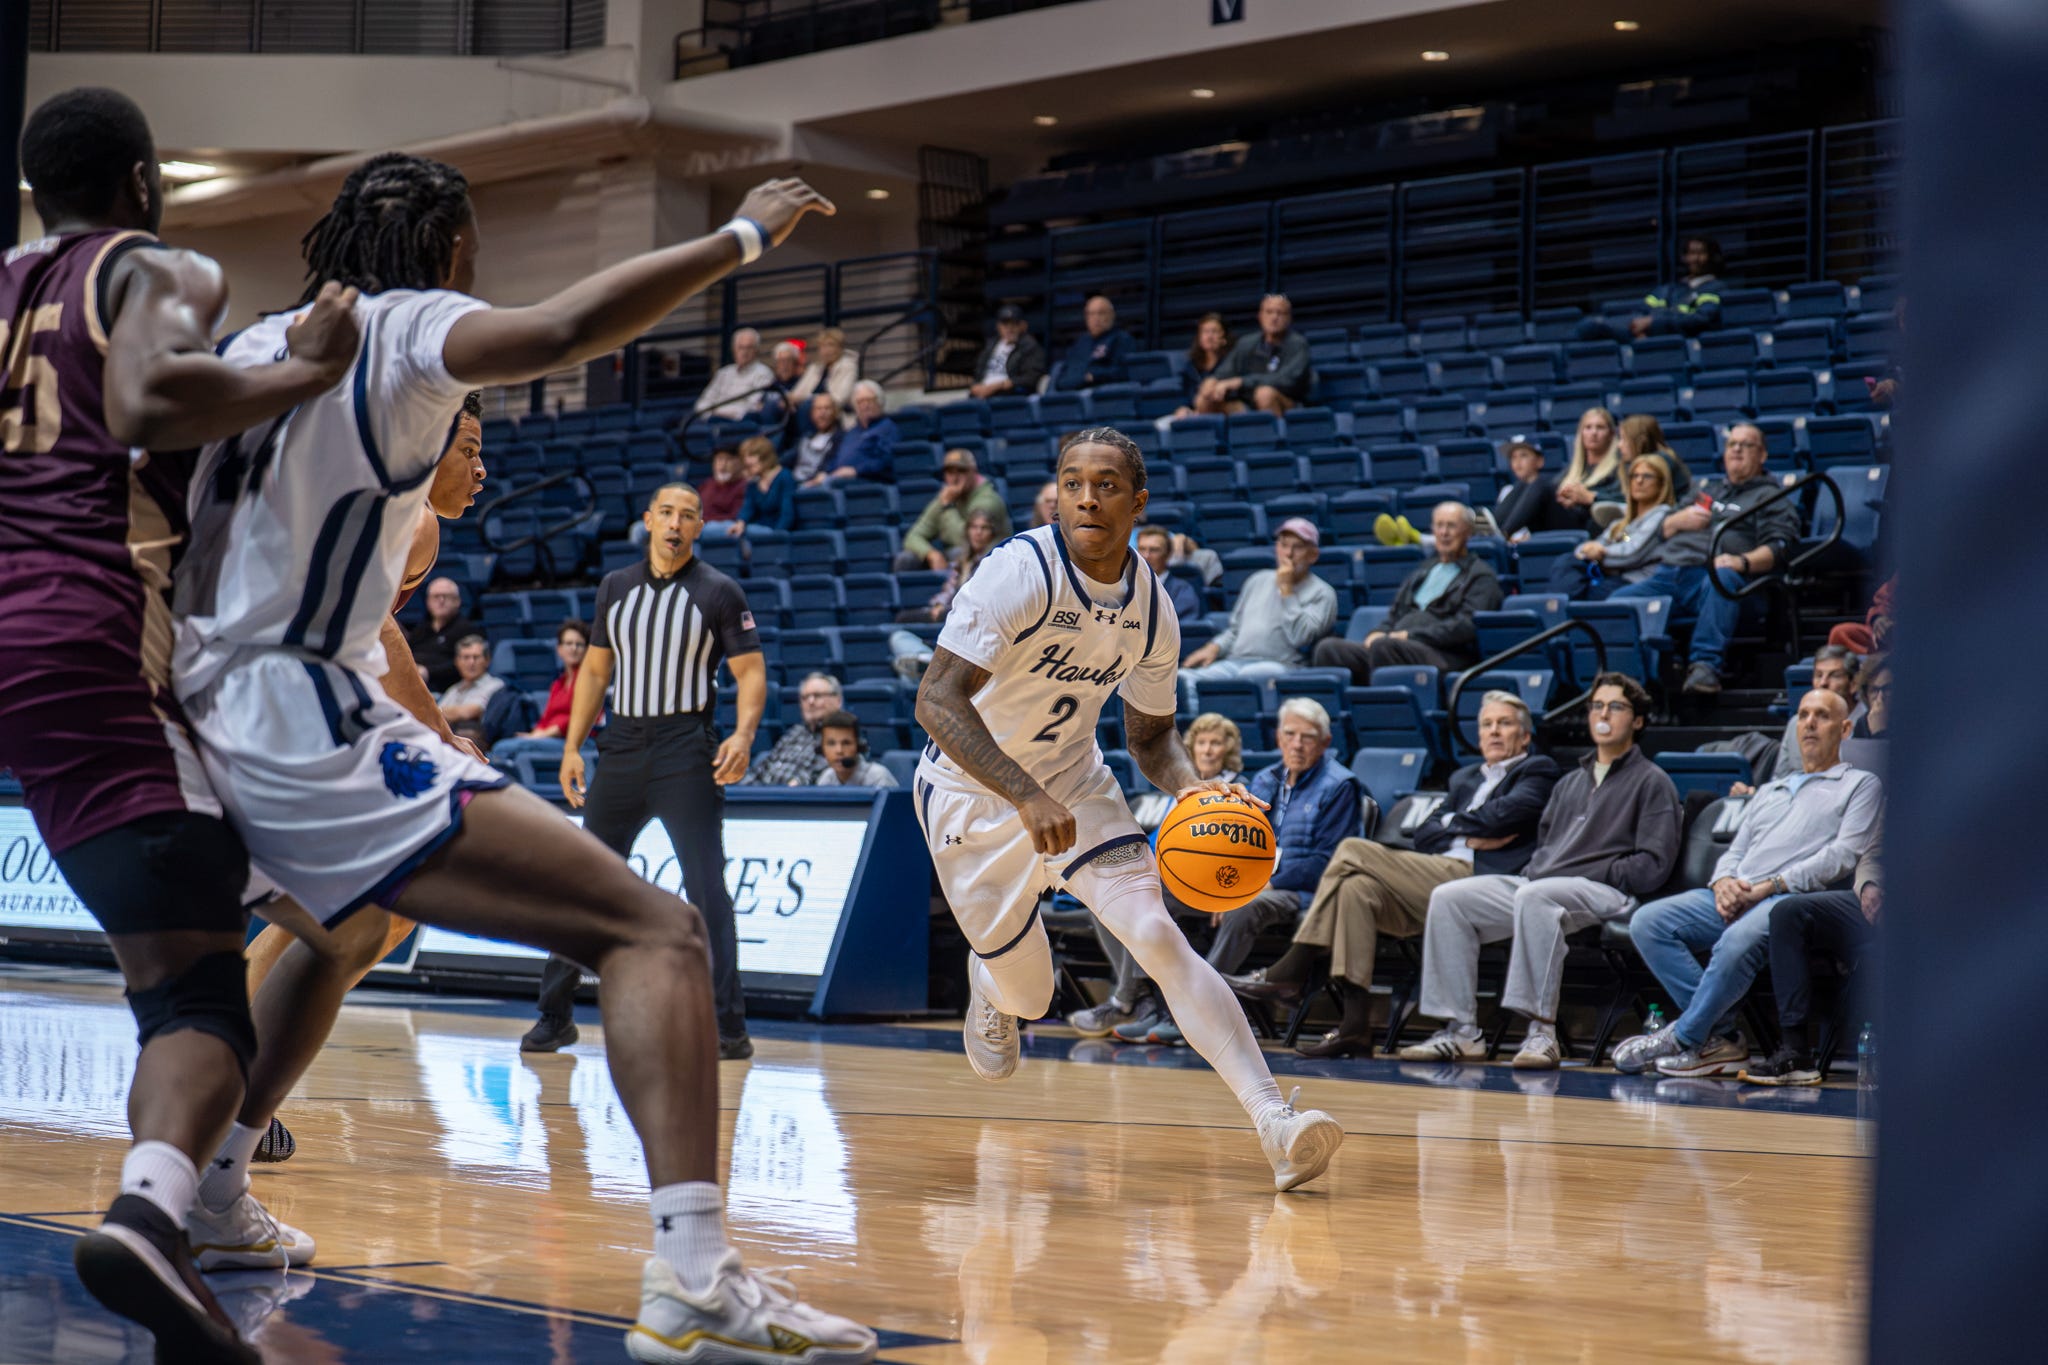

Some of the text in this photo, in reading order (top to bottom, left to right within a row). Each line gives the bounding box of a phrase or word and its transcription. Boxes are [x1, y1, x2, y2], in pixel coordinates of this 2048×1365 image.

[0, 302, 64, 454] 5
[1052, 610, 1081, 626] BSI
[1122, 619, 1141, 630] CAA
[1029, 693, 1080, 744] 2
[1190, 821, 1268, 851] Wilson
[2, 835, 58, 884] OO
